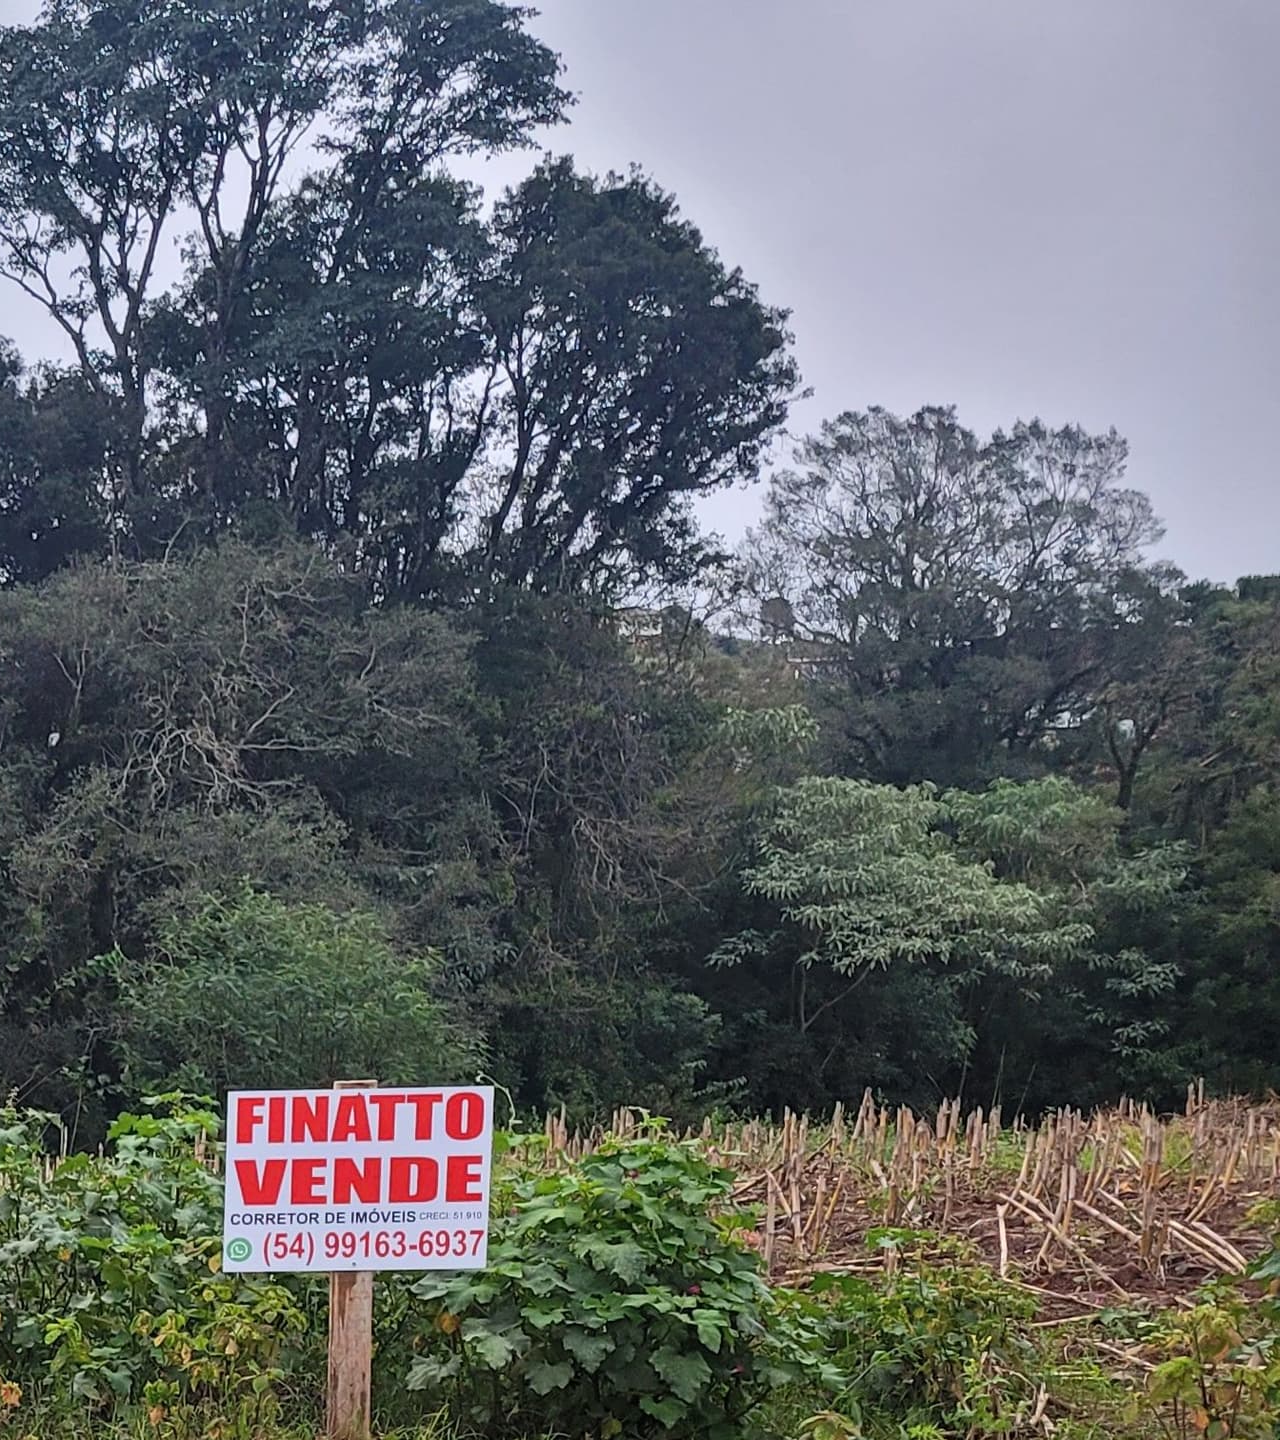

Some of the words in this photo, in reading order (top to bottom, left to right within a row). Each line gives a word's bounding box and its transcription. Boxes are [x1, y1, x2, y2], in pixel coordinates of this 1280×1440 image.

[236, 1092, 485, 1144] FINATTO
[234, 1155, 483, 1205] VENDE
[230, 1213, 319, 1225] CORRETOR
[324, 1212, 346, 1224] DE
[350, 1208, 416, 1224] IMÓVEIS
[263, 1231, 315, 1267] (54)
[324, 1229, 485, 1258] 99163-6937
